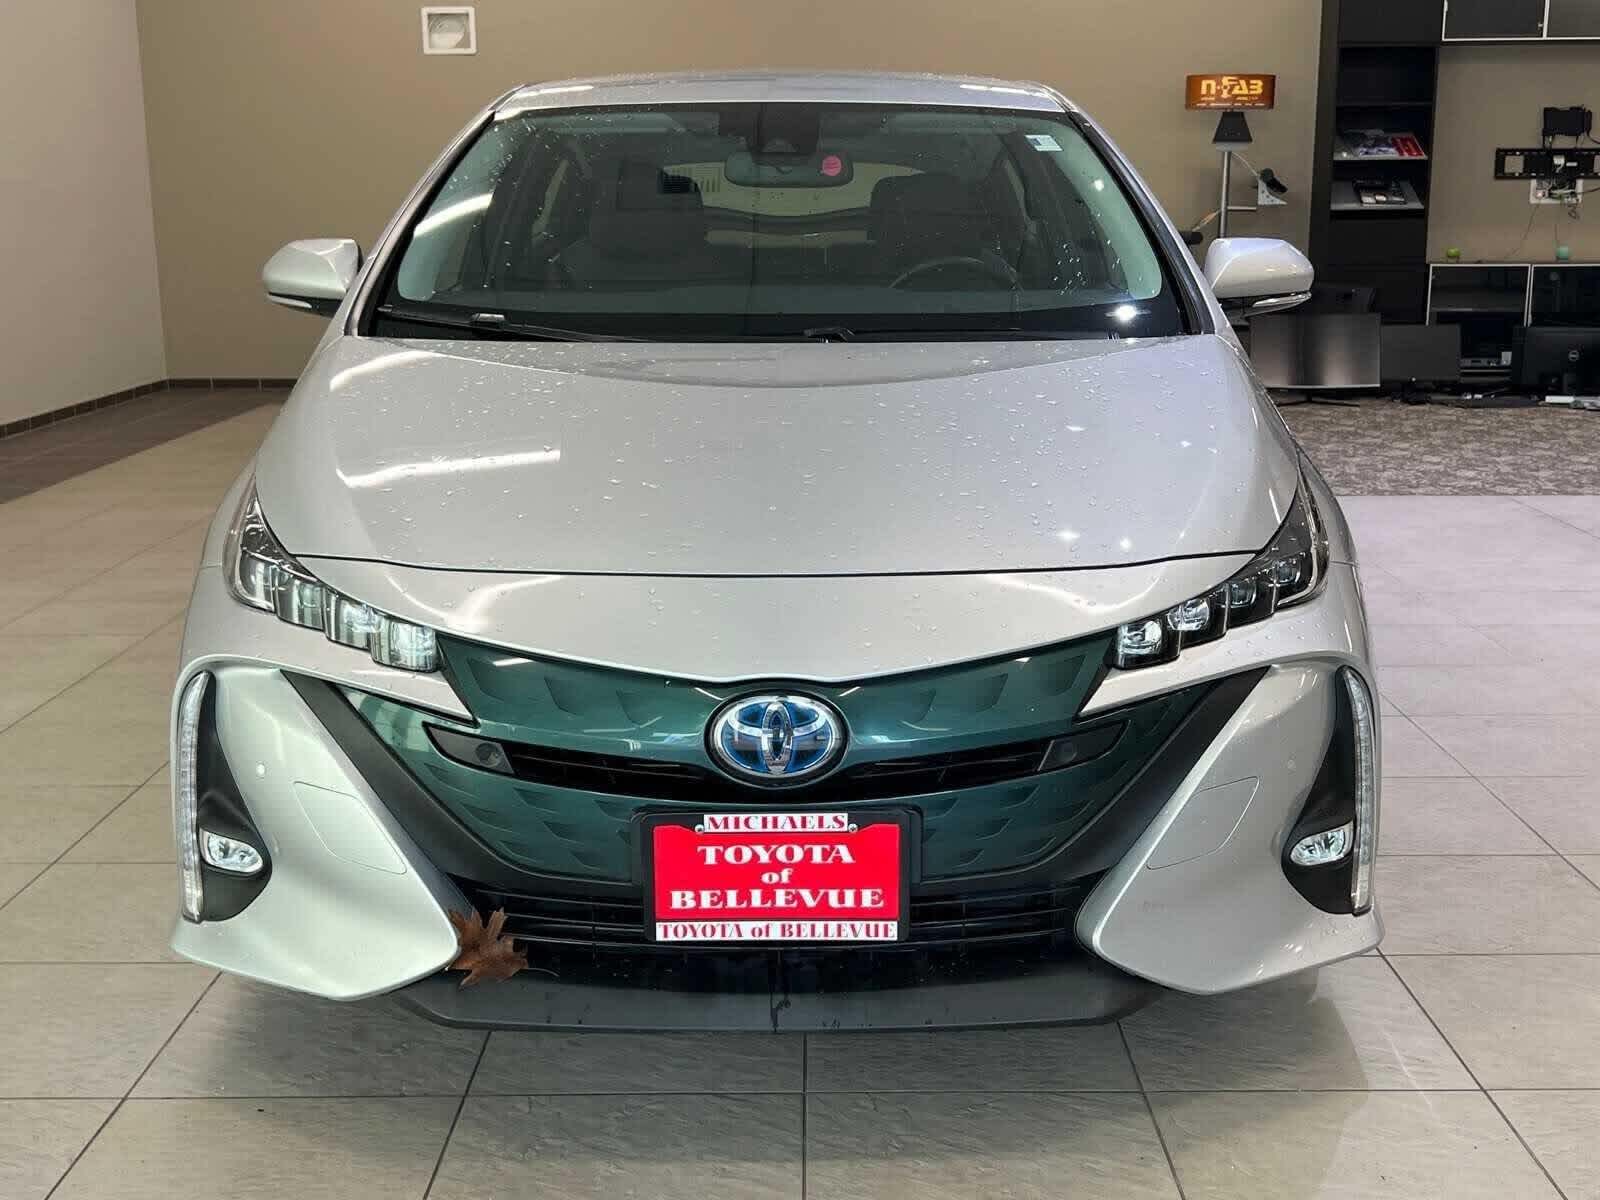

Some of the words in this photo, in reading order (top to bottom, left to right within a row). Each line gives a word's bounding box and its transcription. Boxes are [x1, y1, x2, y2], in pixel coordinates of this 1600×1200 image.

[707, 814, 846, 830] MICHAELS
[697, 844, 856, 865] TOYOTA
[761, 868, 793, 885] of
[670, 888, 884, 909] BELLEVUE
[658, 923, 743, 939] TOYOTA
[751, 922, 773, 938] of
[780, 922, 897, 938] BELLEVUE
